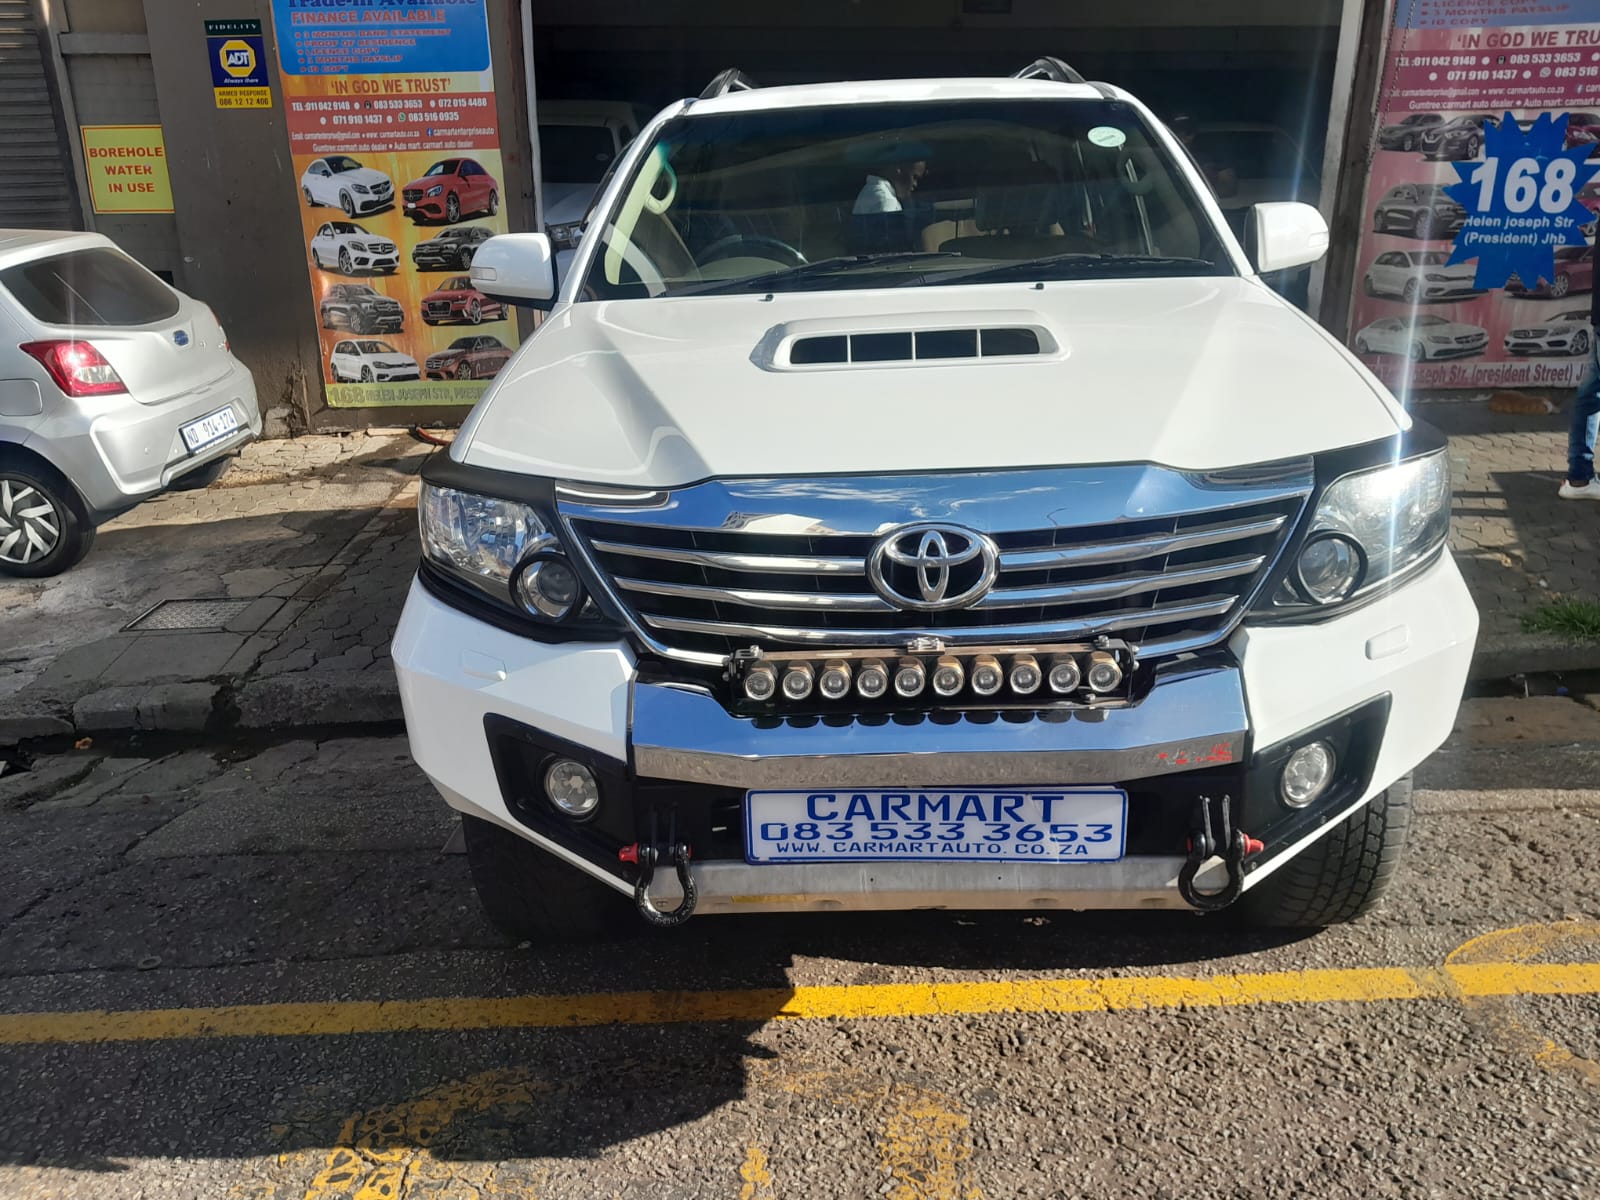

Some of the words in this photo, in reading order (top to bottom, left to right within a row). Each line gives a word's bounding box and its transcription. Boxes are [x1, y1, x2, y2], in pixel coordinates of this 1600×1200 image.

[291, 11, 357, 25] FINANCE
[362, 9, 445, 23] AVAILABLE
[1444, 8, 1507, 17] MONTHS
[1486, 33, 1524, 48] GOD
[1530, 31, 1558, 46] WE
[227, 51, 250, 66] ADT
[1452, 55, 1476, 66] 9148
[1510, 54, 1530, 65] 083
[1531, 53, 1552, 64] 533
[1553, 52, 1581, 63] 3653
[1447, 71, 1466, 81] 071
[1468, 70, 1489, 81] 910
[1491, 69, 1518, 80] 1437
[1555, 67, 1576, 77] 083
[218, 89, 238, 97] ARMED
[239, 89, 267, 97] RESPONSE
[353, 79, 380, 94] GOD
[382, 78, 404, 93] WE
[235, 98, 243, 106] 12
[246, 98, 254, 106] 12
[1472, 100, 1489, 109] auto
[1490, 99, 1514, 109] dealer
[1523, 98, 1542, 107] Auto
[1564, 96, 1595, 106] carmart
[364, 114, 382, 124] 1437
[89, 146, 164, 158] BOREHOLE
[104, 165, 152, 175] WATER
[108, 183, 123, 193] IN
[127, 182, 155, 193] USE
[1470, 156, 1577, 214] 168
[1464, 216, 1501, 227] Helen
[1504, 215, 1550, 230] joseph
[1554, 215, 1575, 228] Str
[1463, 231, 1538, 246] (President)
[1541, 232, 1567, 245] Jhb
[1533, 362, 1574, 384] Street)
[331, 386, 367, 404] 168
[367, 388, 396, 401] HELEN
[398, 387, 432, 401] JOSEPH
[806, 793, 1065, 823] CARMART
[760, 822, 854, 841] 083
[870, 822, 966, 841] 533
[982, 823, 1113, 842] 3653
